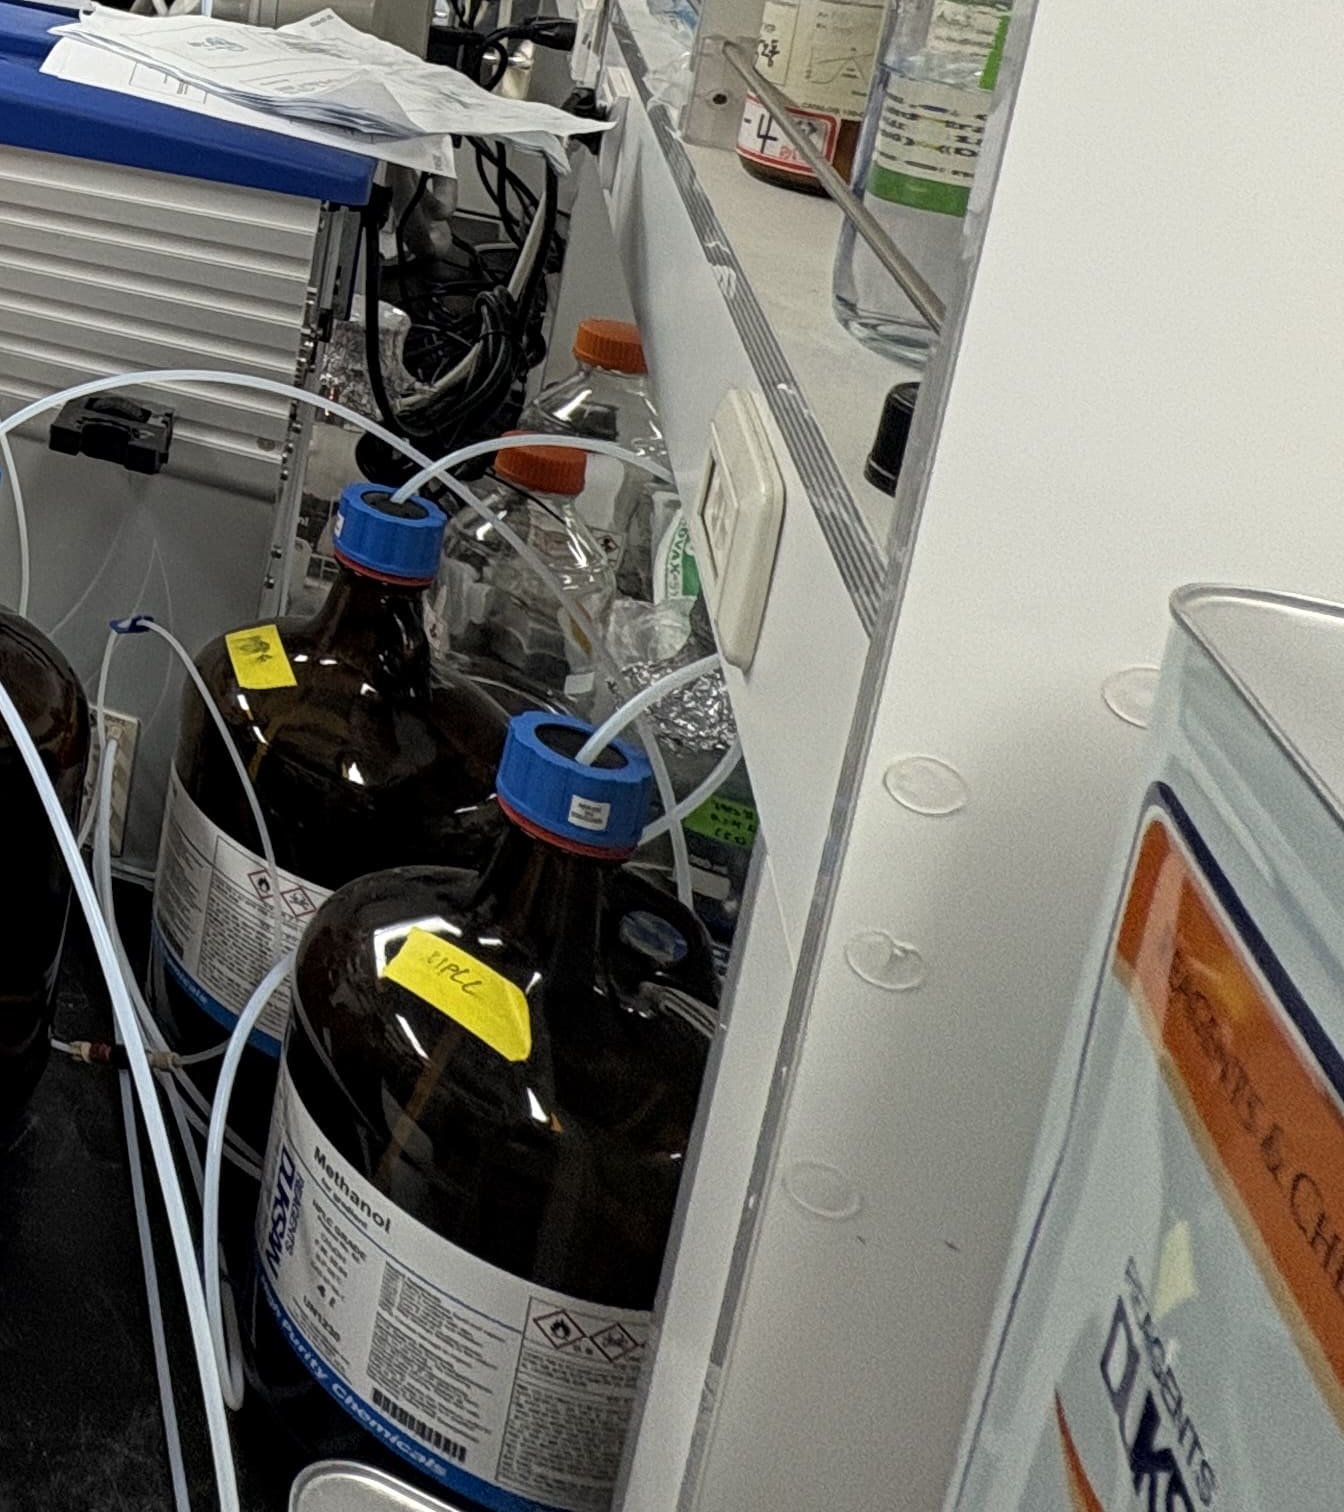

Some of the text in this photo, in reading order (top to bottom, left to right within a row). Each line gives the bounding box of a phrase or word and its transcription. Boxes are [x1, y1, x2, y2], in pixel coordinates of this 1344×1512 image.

[313, 1145, 392, 1235] Methanol
[281, 1318, 329, 1380] Purity
[331, 1382, 448, 1478] Chemicals
